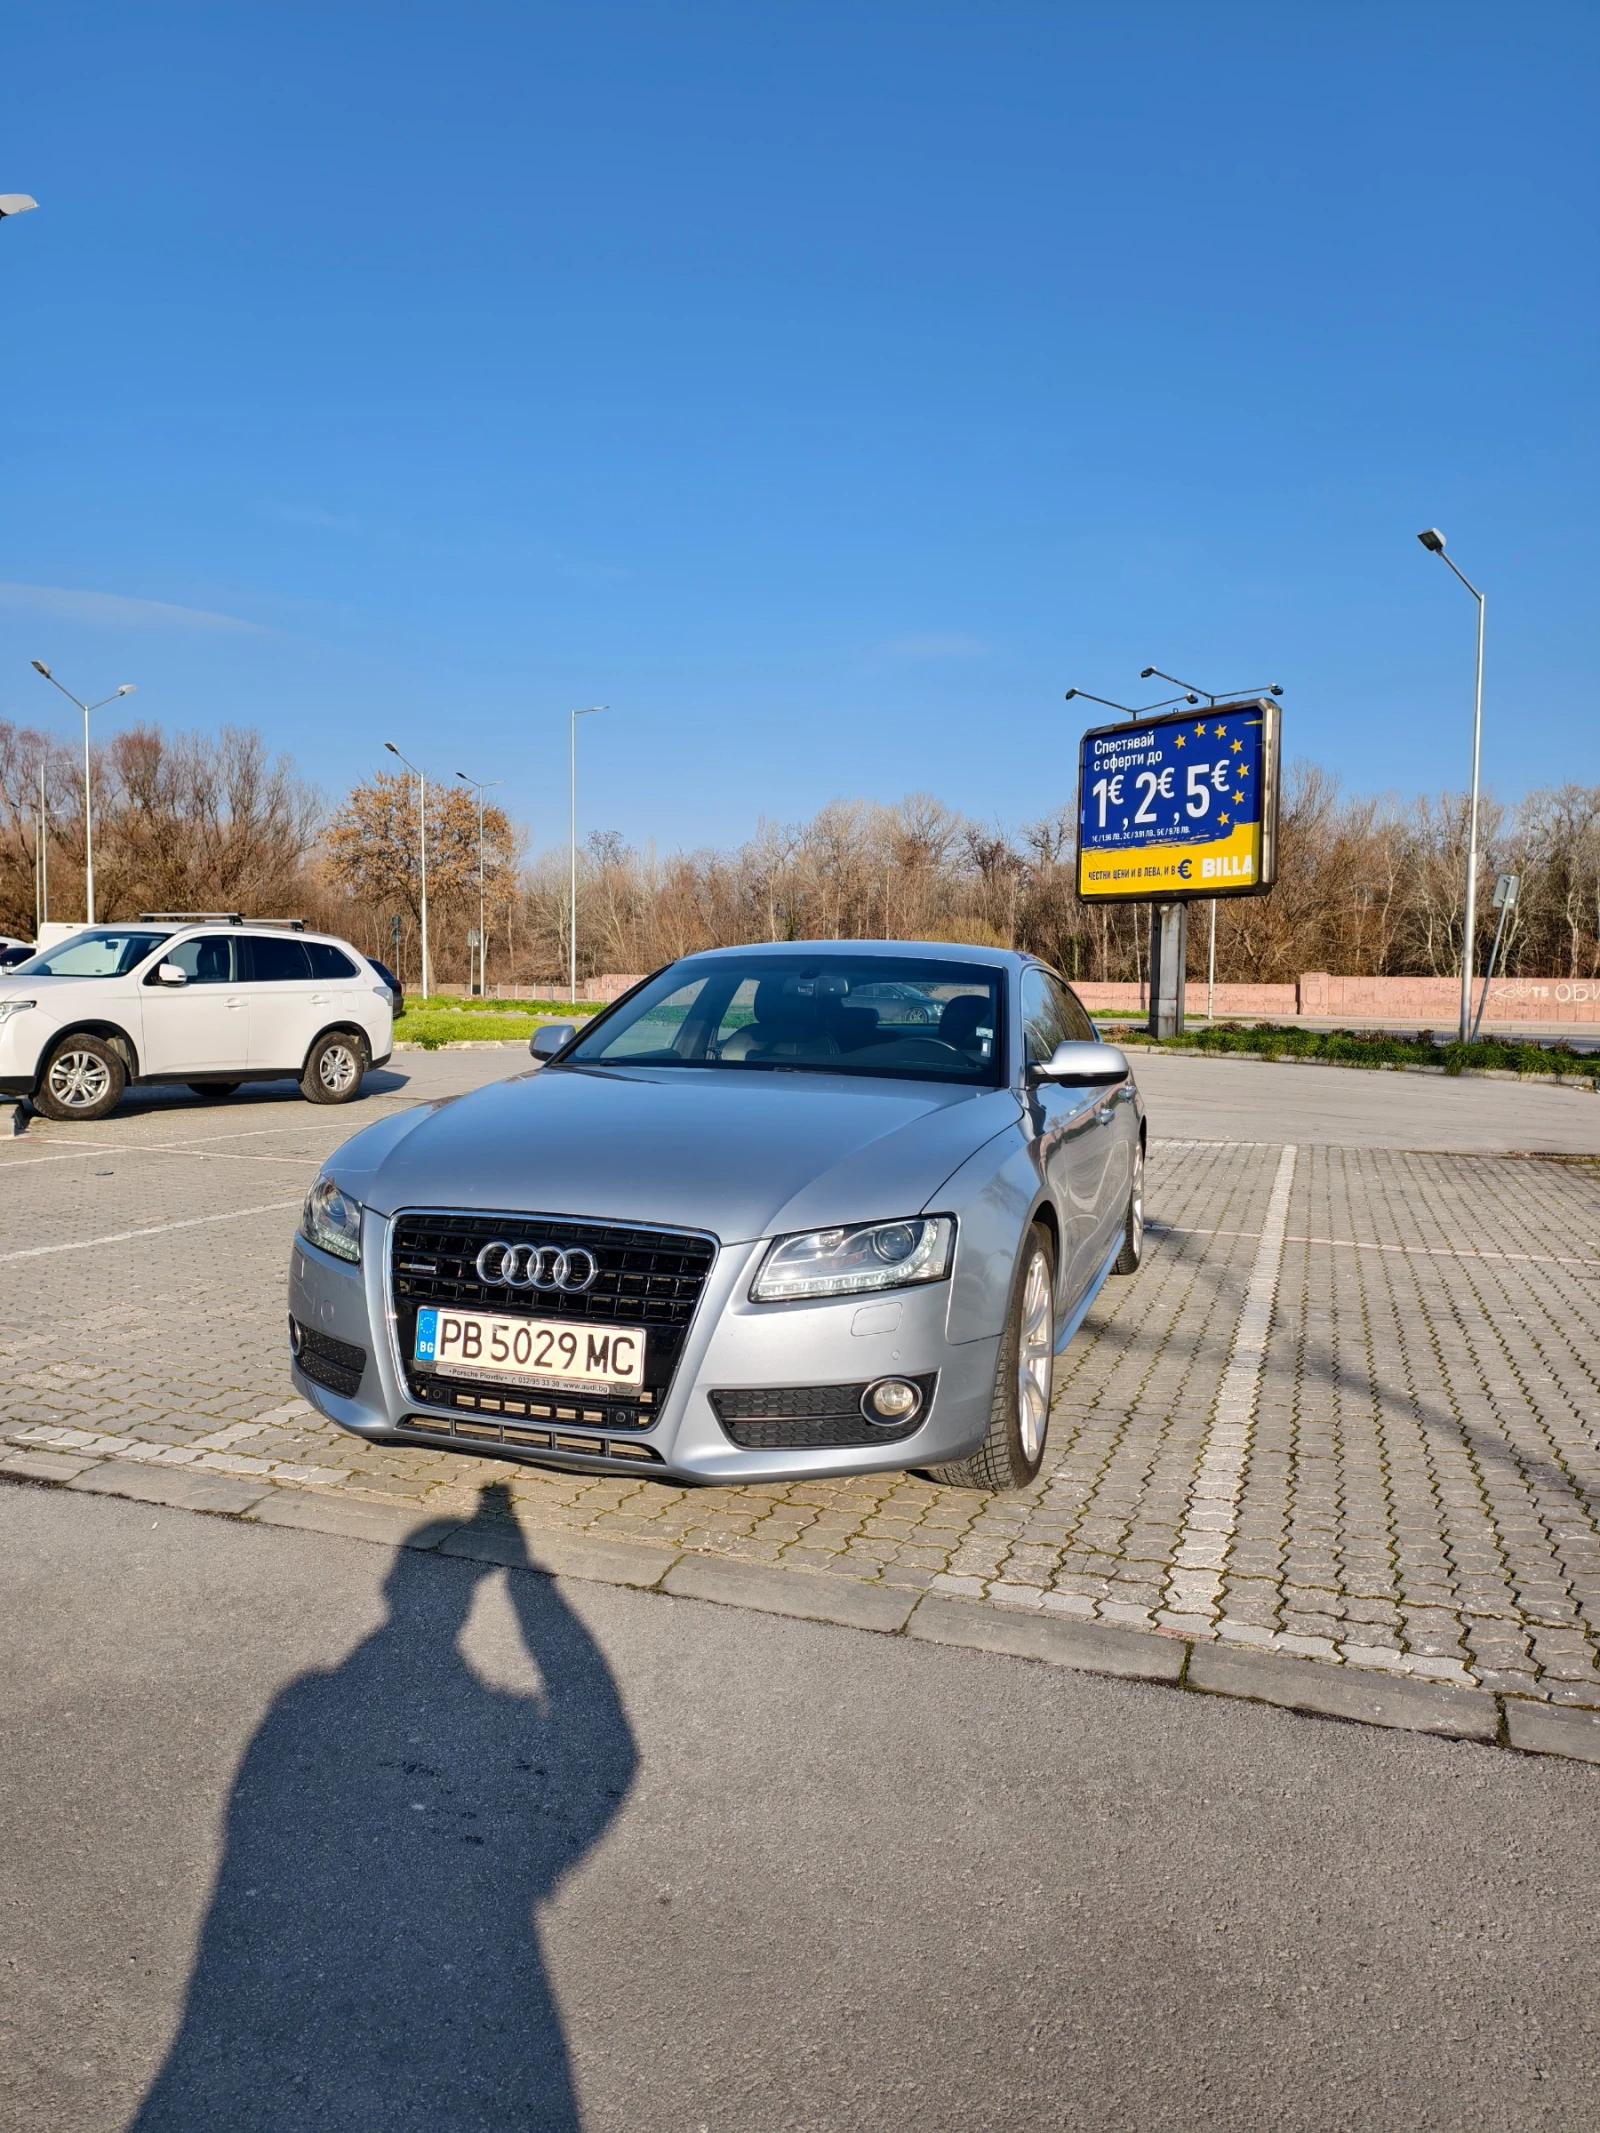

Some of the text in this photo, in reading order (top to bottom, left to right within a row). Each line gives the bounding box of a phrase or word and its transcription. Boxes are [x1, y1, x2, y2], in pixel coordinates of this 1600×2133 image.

[1094, 730, 1155, 755] Спестявай
[1093, 750, 1163, 773] с оферти до
[1185, 759, 1230, 818] 5€
[1088, 870, 1111, 881] ЧЕСТНИ
[1201, 854, 1255, 879] BILLA
[419, 1339, 435, 1354] BG
[439, 1317, 636, 1376] PB 5029 MC
[452, 1368, 479, 1379] Porsche
[479, 1372, 504, 1382] Plovdiv
[563, 1381, 608, 1393] www.audi.bg
